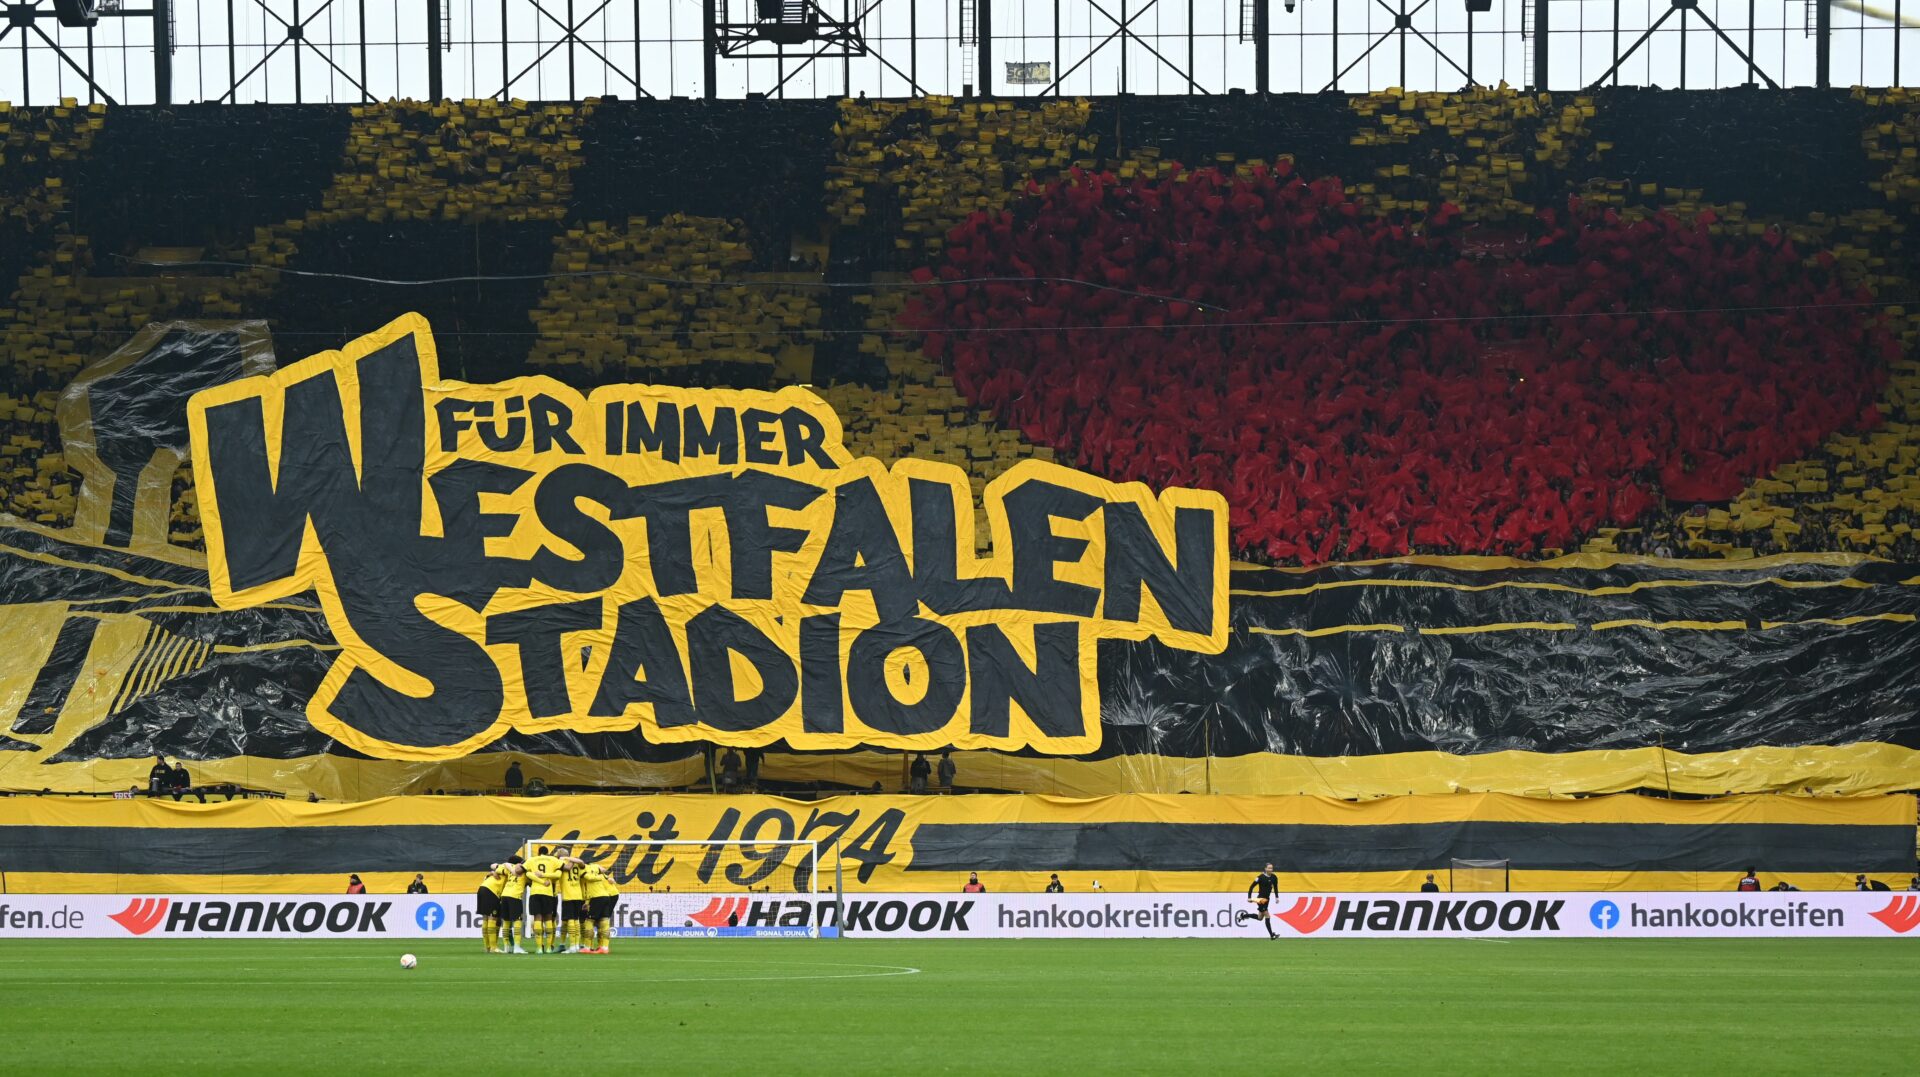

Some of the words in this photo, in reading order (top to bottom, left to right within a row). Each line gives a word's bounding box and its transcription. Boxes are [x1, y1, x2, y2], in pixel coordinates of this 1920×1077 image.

[434, 392, 584, 455] FÜR
[604, 398, 839, 469] IMMER
[205, 330, 1215, 636] WESTFALEN
[326, 586, 1087, 748] STADION
[696, 807, 906, 893] 1974
[998, 903, 1249, 928] hankookreifen.de
[1631, 902, 1844, 927] hankookreifen
